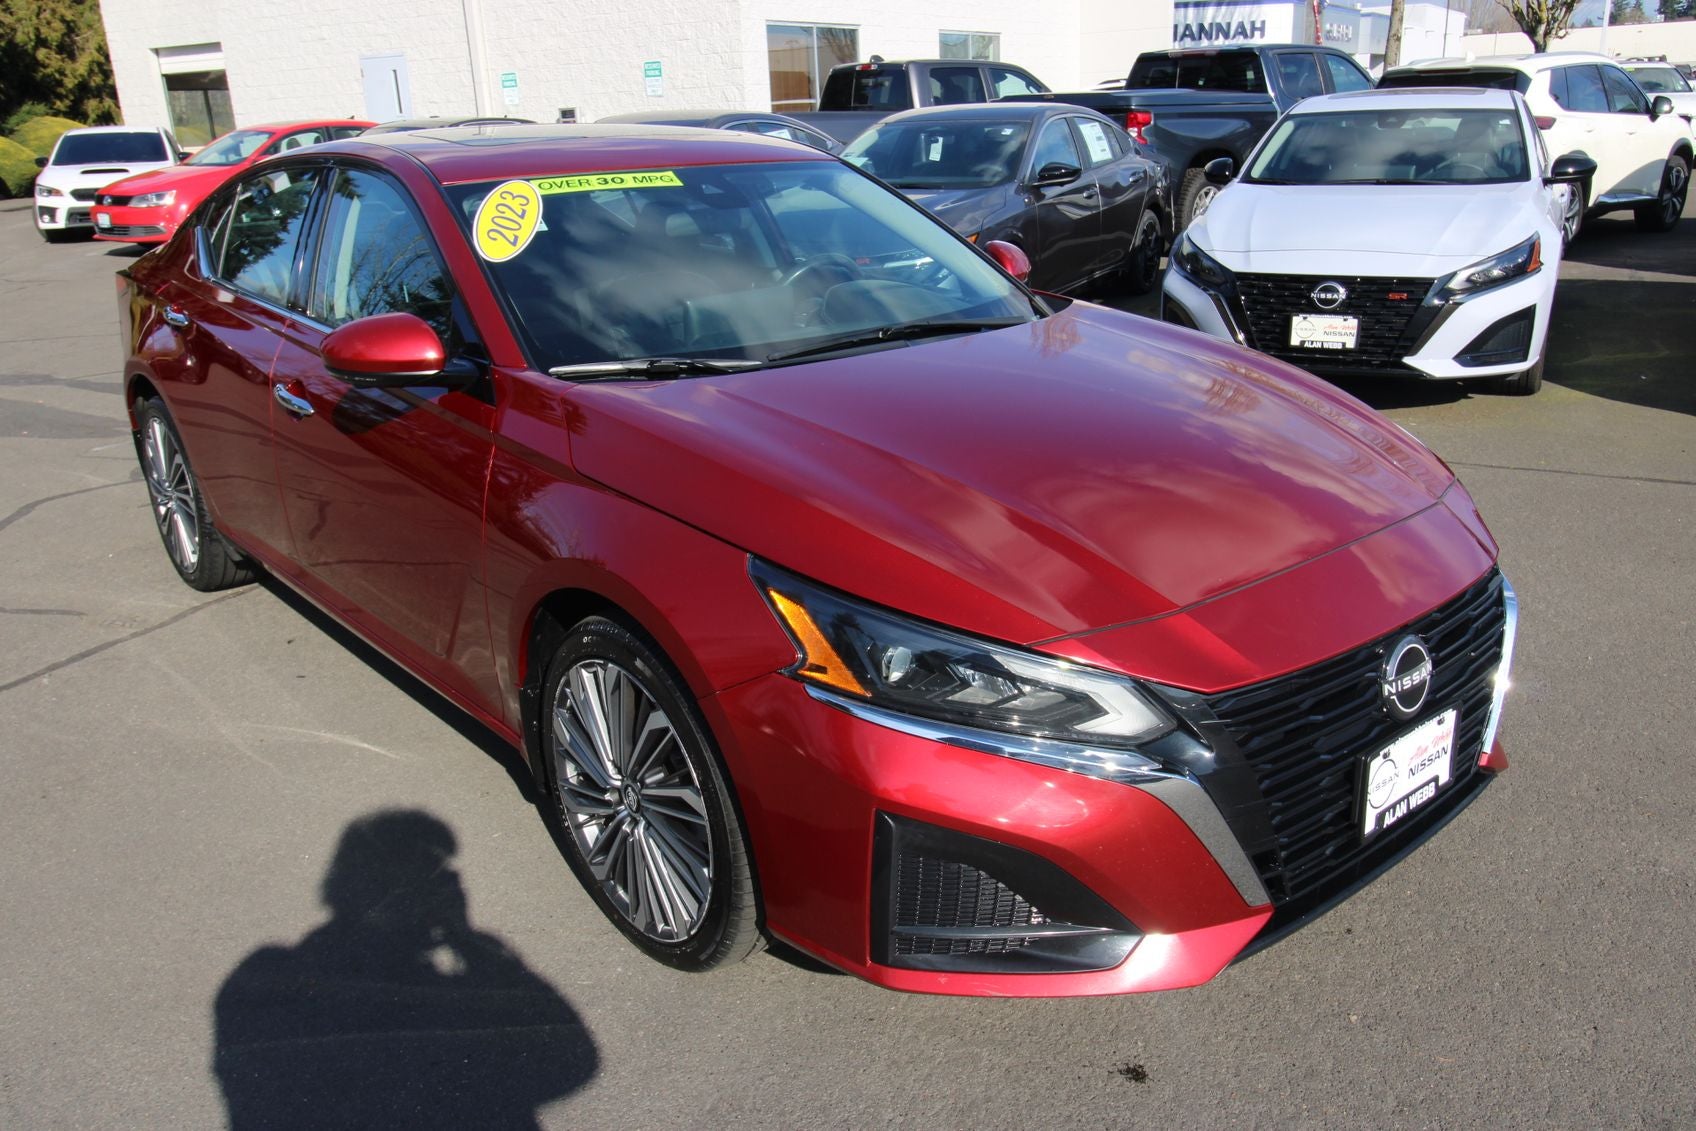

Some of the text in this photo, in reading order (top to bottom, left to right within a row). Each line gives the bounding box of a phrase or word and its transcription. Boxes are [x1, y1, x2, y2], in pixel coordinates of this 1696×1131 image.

[537, 174, 674, 190] OVER 30 MPG
[487, 190, 530, 247] 2023
[1310, 291, 1346, 300] NISSAN
[1304, 341, 1343, 350] ALAN WEBB
[1323, 330, 1355, 338] NISSAN
[1384, 661, 1433, 696] NISSAN
[1408, 743, 1449, 780] NISSAN
[1383, 781, 1436, 829] ALAN WEBB
